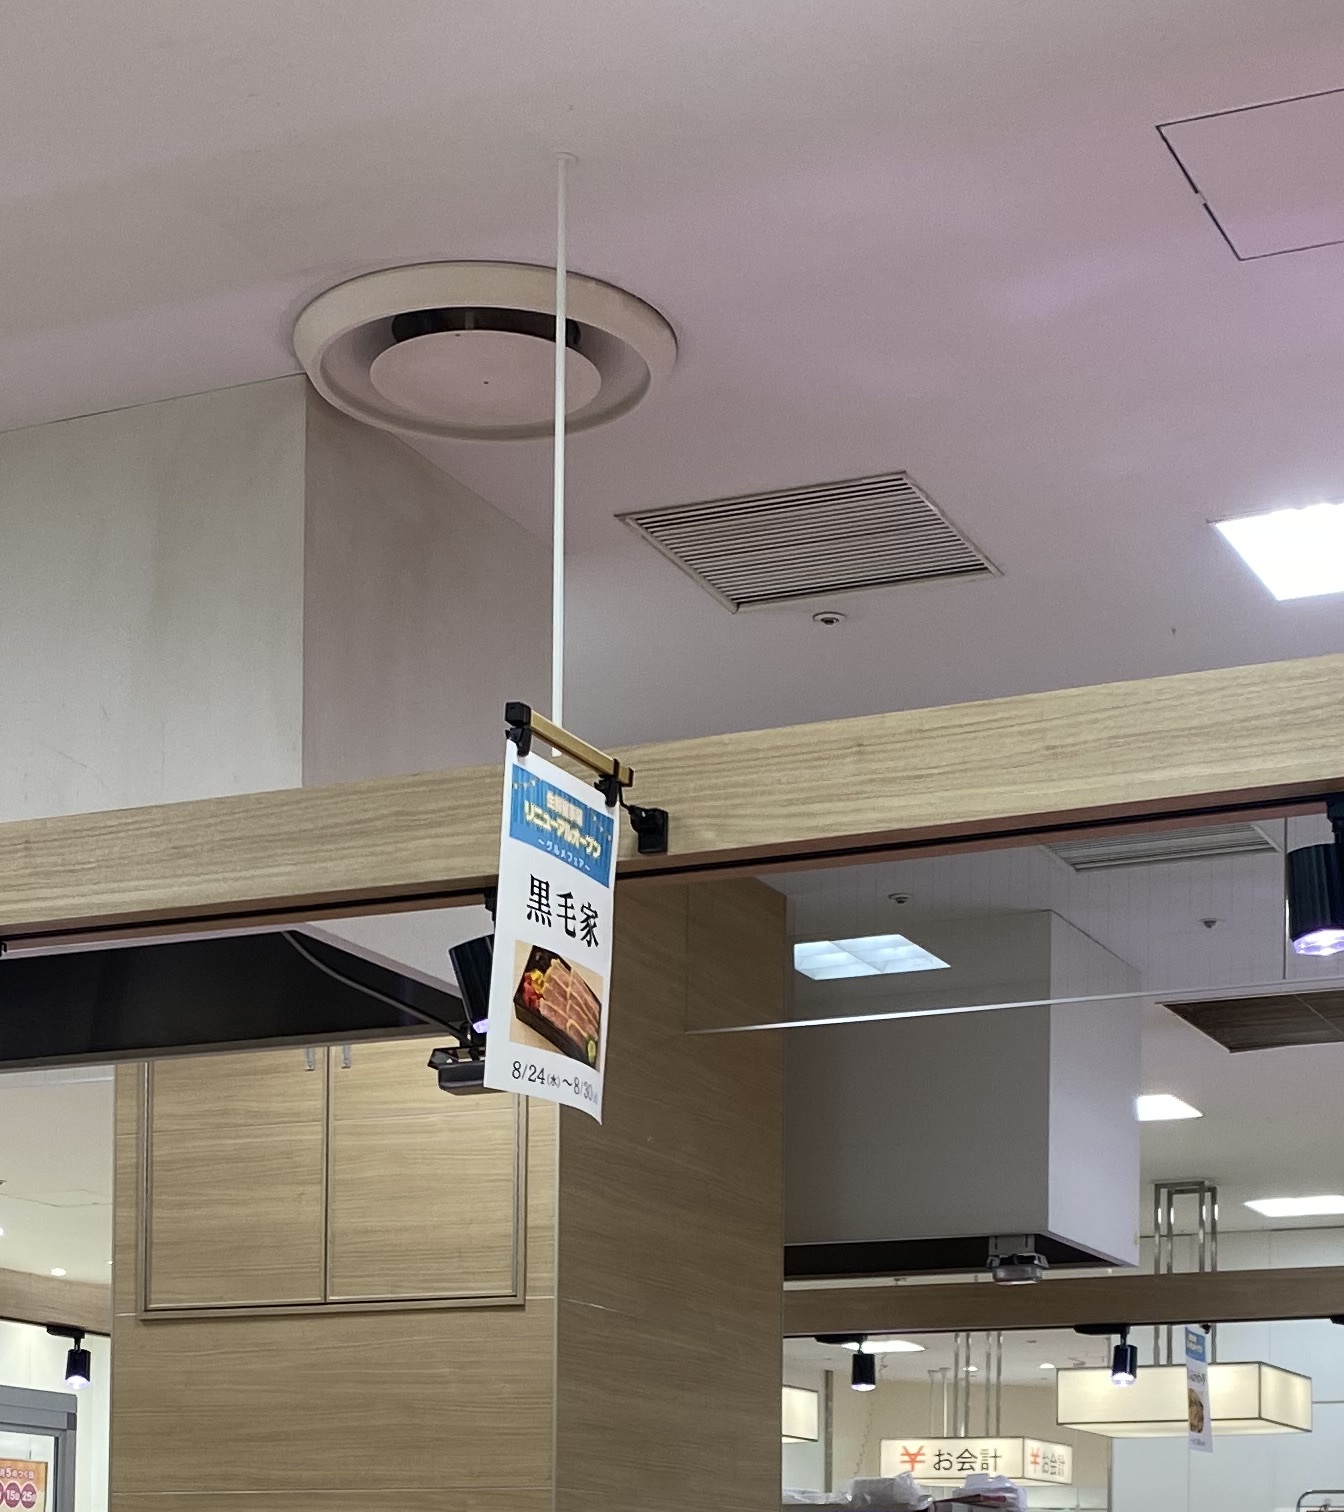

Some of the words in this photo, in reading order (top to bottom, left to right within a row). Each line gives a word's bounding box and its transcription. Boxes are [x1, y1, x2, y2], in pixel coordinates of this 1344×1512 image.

[524, 799, 602, 859] リニューアルオープン
[526, 873, 600, 949] 黒毛家
[933, 1448, 1002, 1473] お会計
